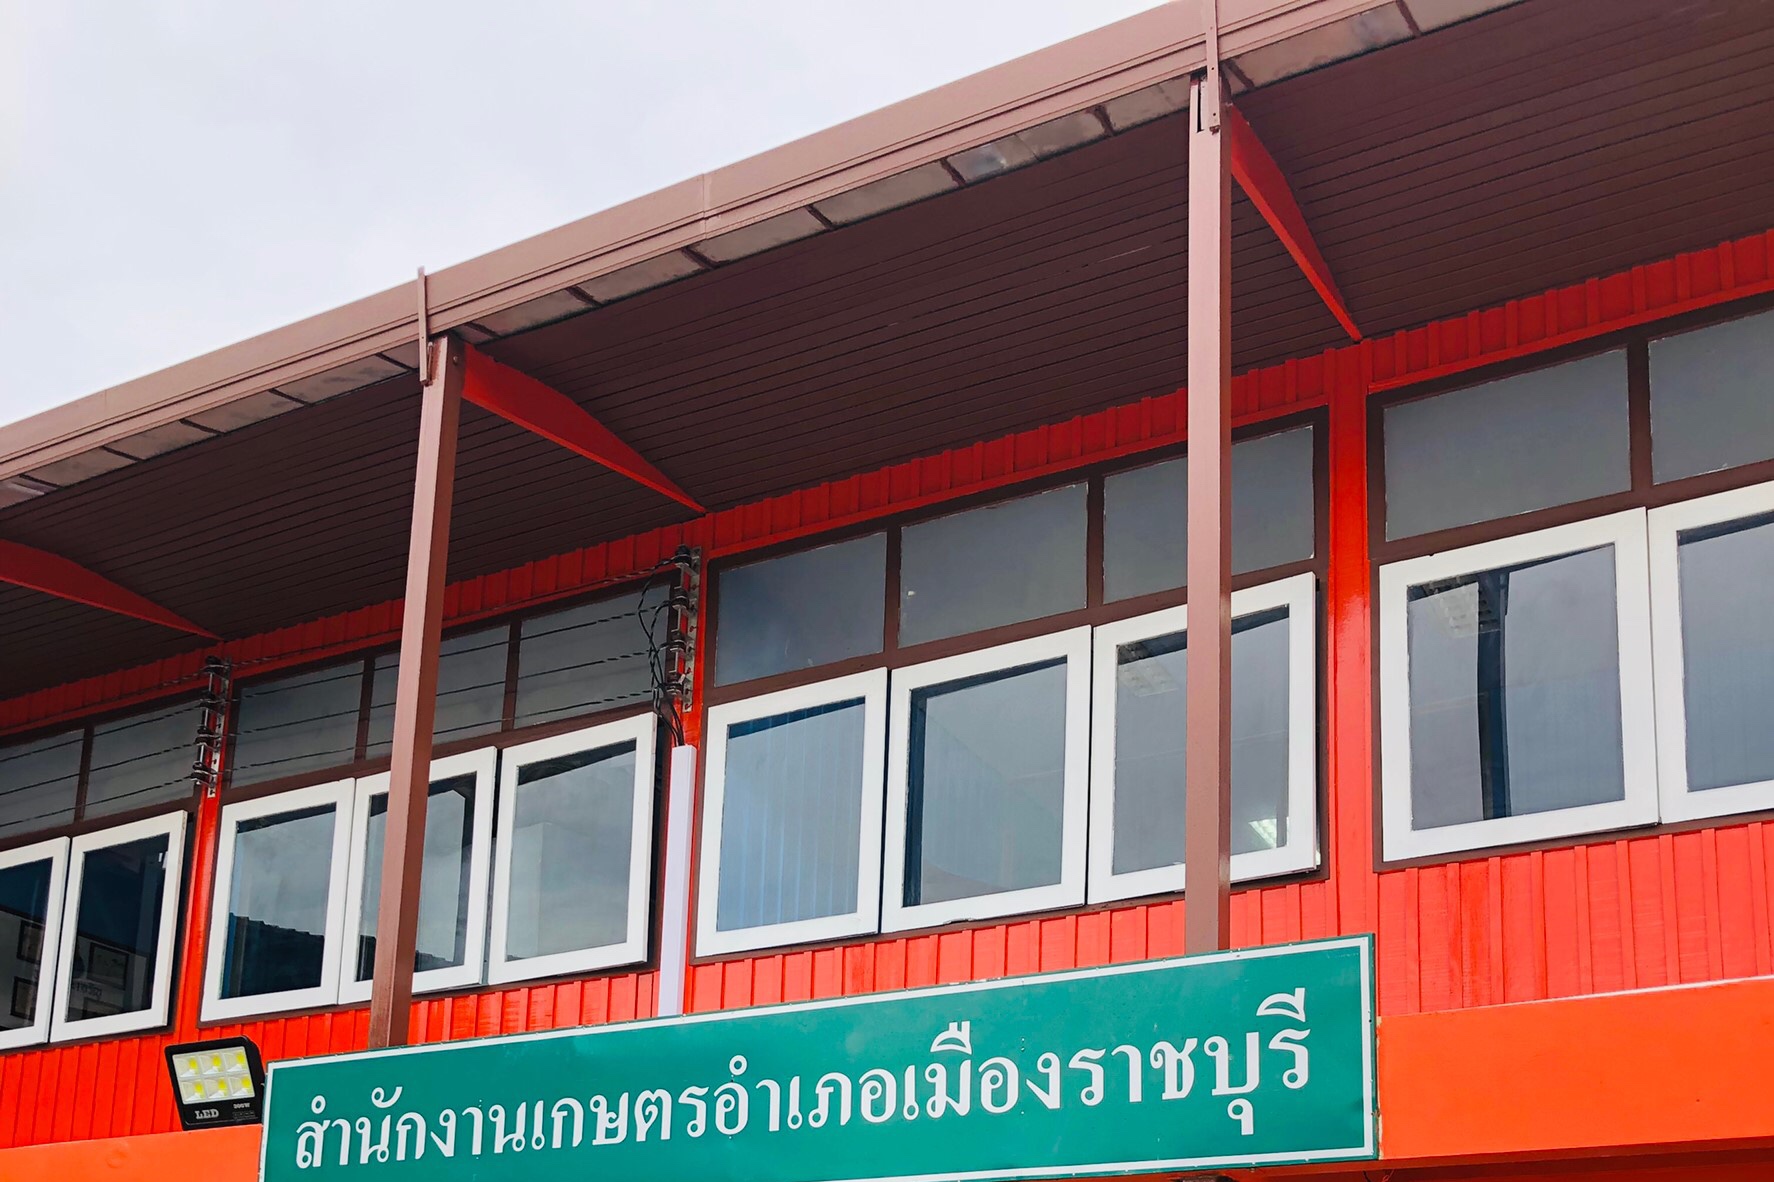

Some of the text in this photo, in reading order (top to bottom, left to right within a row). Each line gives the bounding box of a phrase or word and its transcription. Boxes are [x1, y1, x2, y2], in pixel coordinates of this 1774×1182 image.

[195, 1108, 219, 1120] LED
[295, 987, 1311, 1169] สำนักงานเกษตรอำเภอเมืองราชบุรี
